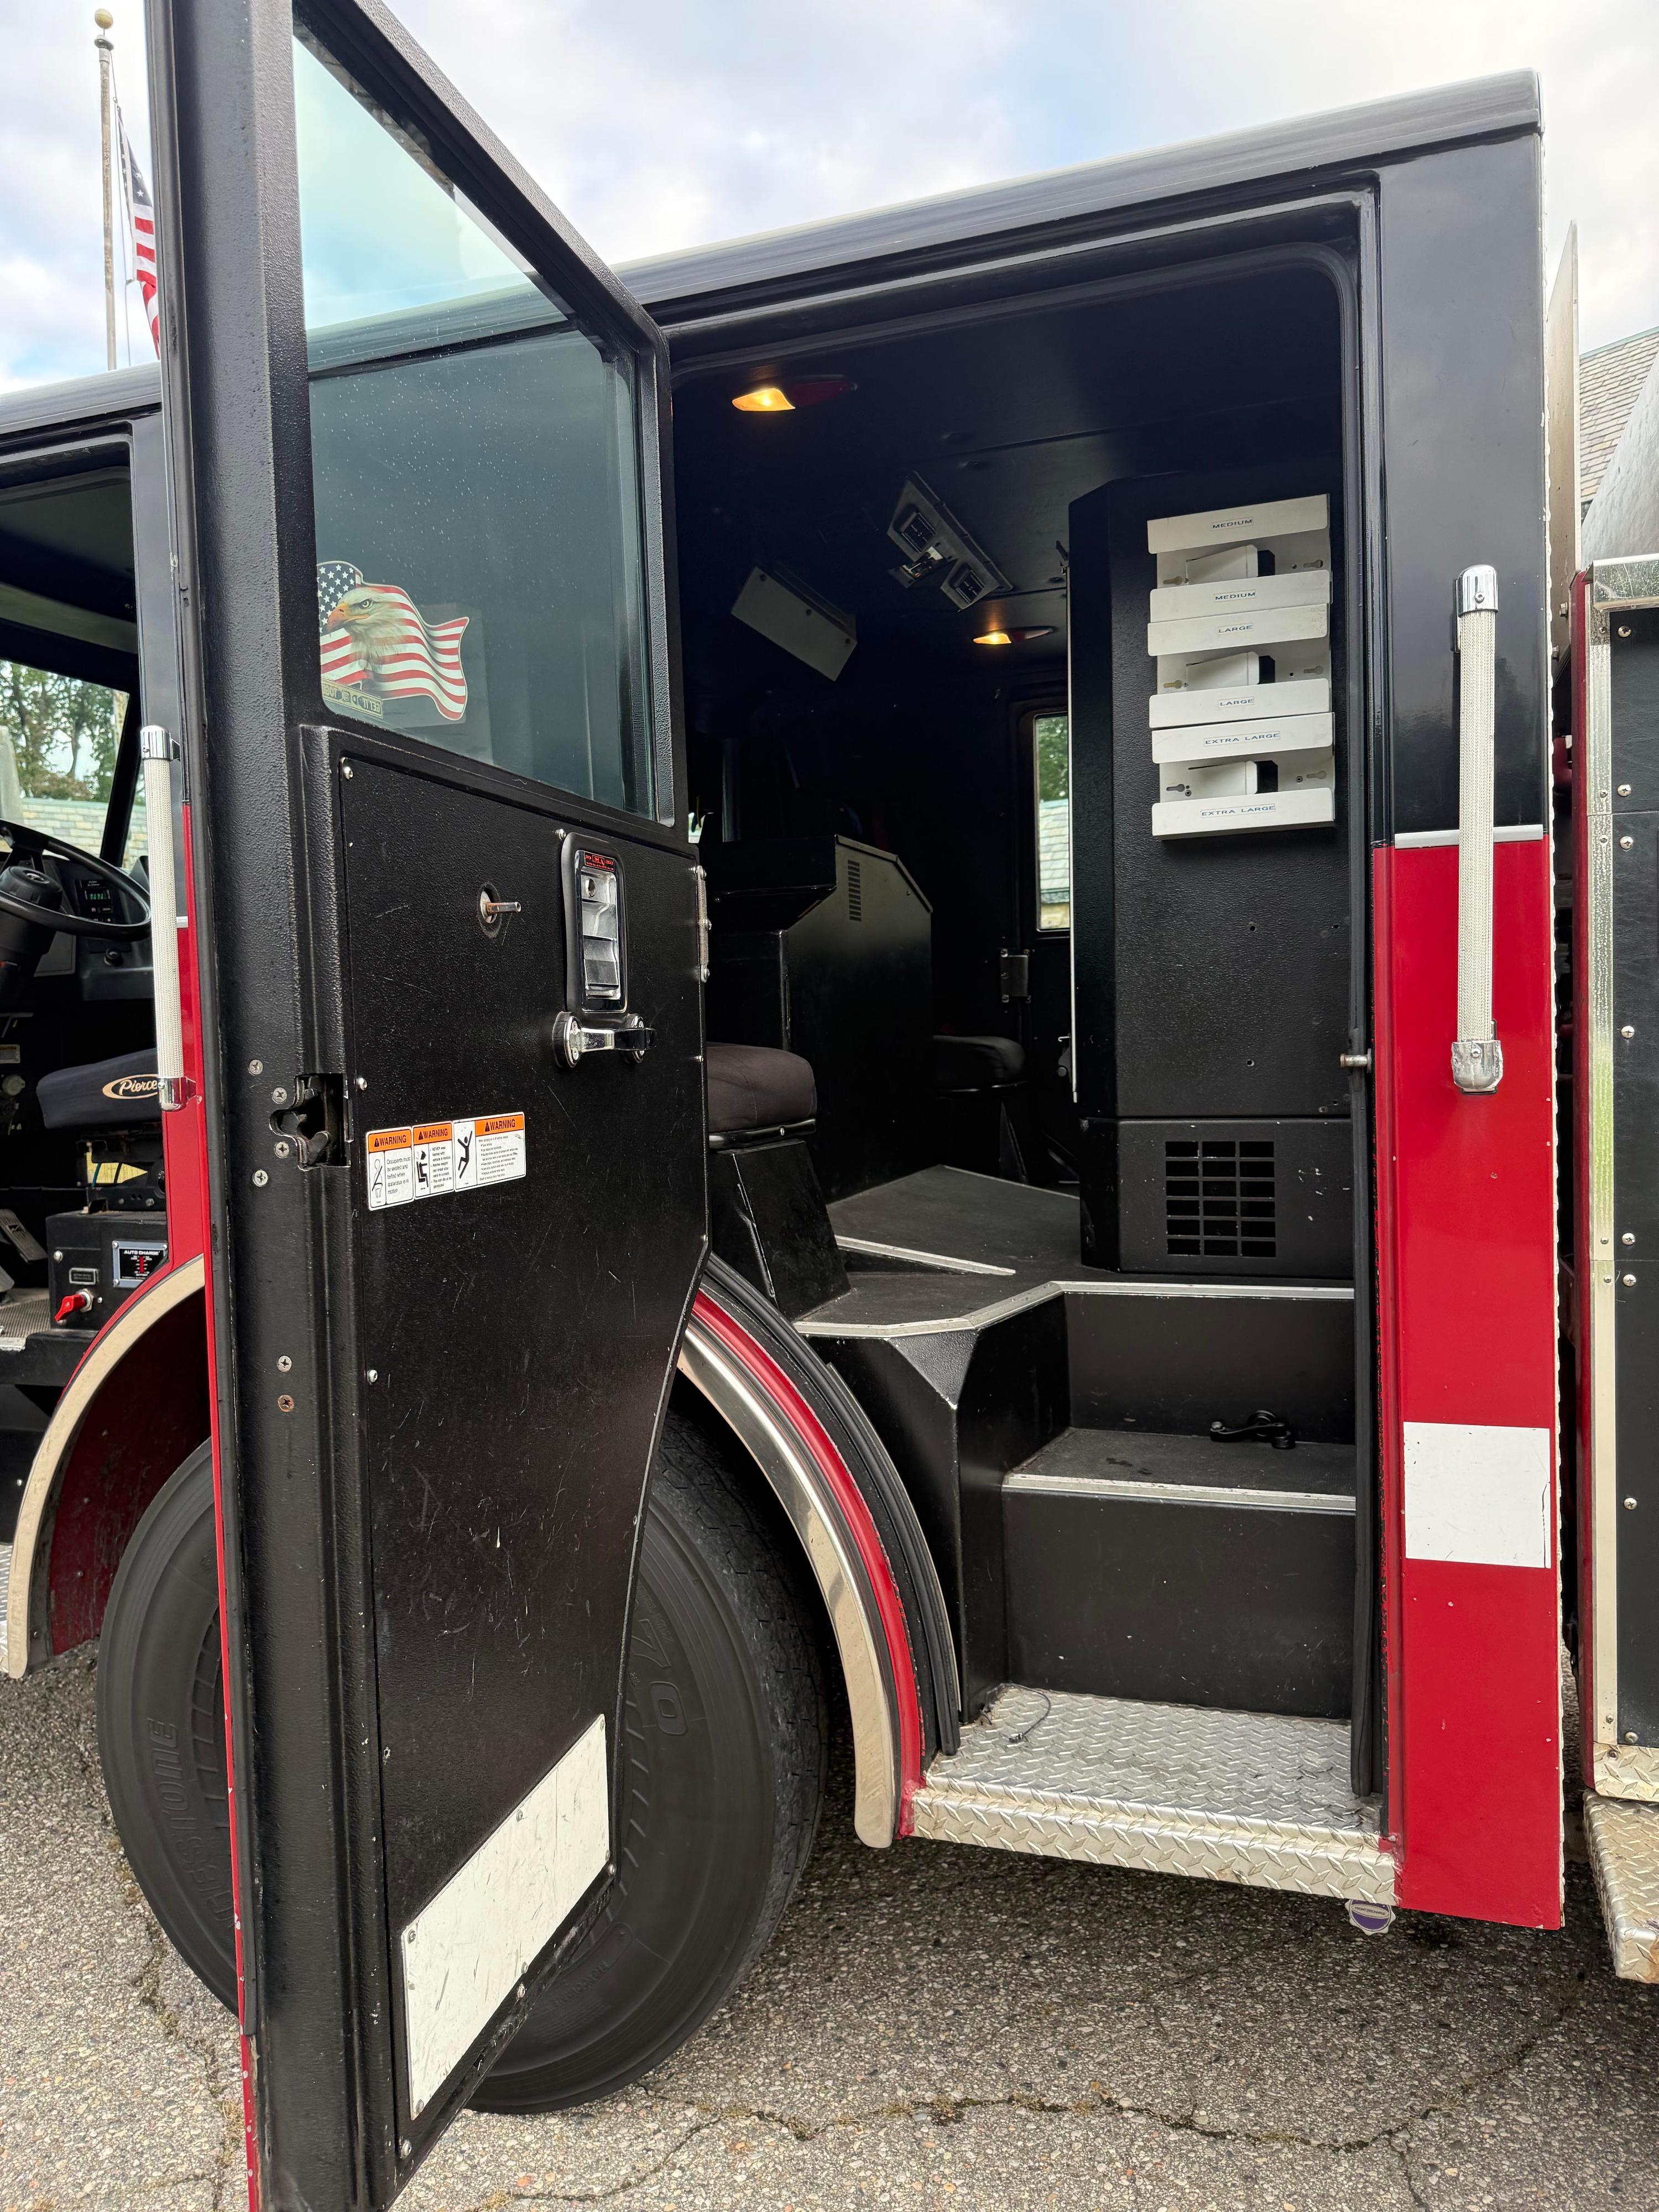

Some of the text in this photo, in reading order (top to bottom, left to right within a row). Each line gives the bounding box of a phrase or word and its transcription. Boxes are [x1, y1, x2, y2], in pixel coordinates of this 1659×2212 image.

[1212, 519, 1252, 529] MEDIUM
[1215, 592, 1256, 601] MEDIUM
[1218, 624, 1253, 633] LARGE
[1219, 698, 1254, 707] LARGE
[1205, 732, 1279, 745] EXTRA LARGE
[119, 1079, 157, 1097] Pierce
[490, 1119, 515, 1131] WARNING
[424, 1129, 448, 1139] WARNING
[379, 1135, 406, 1146] WARNING
